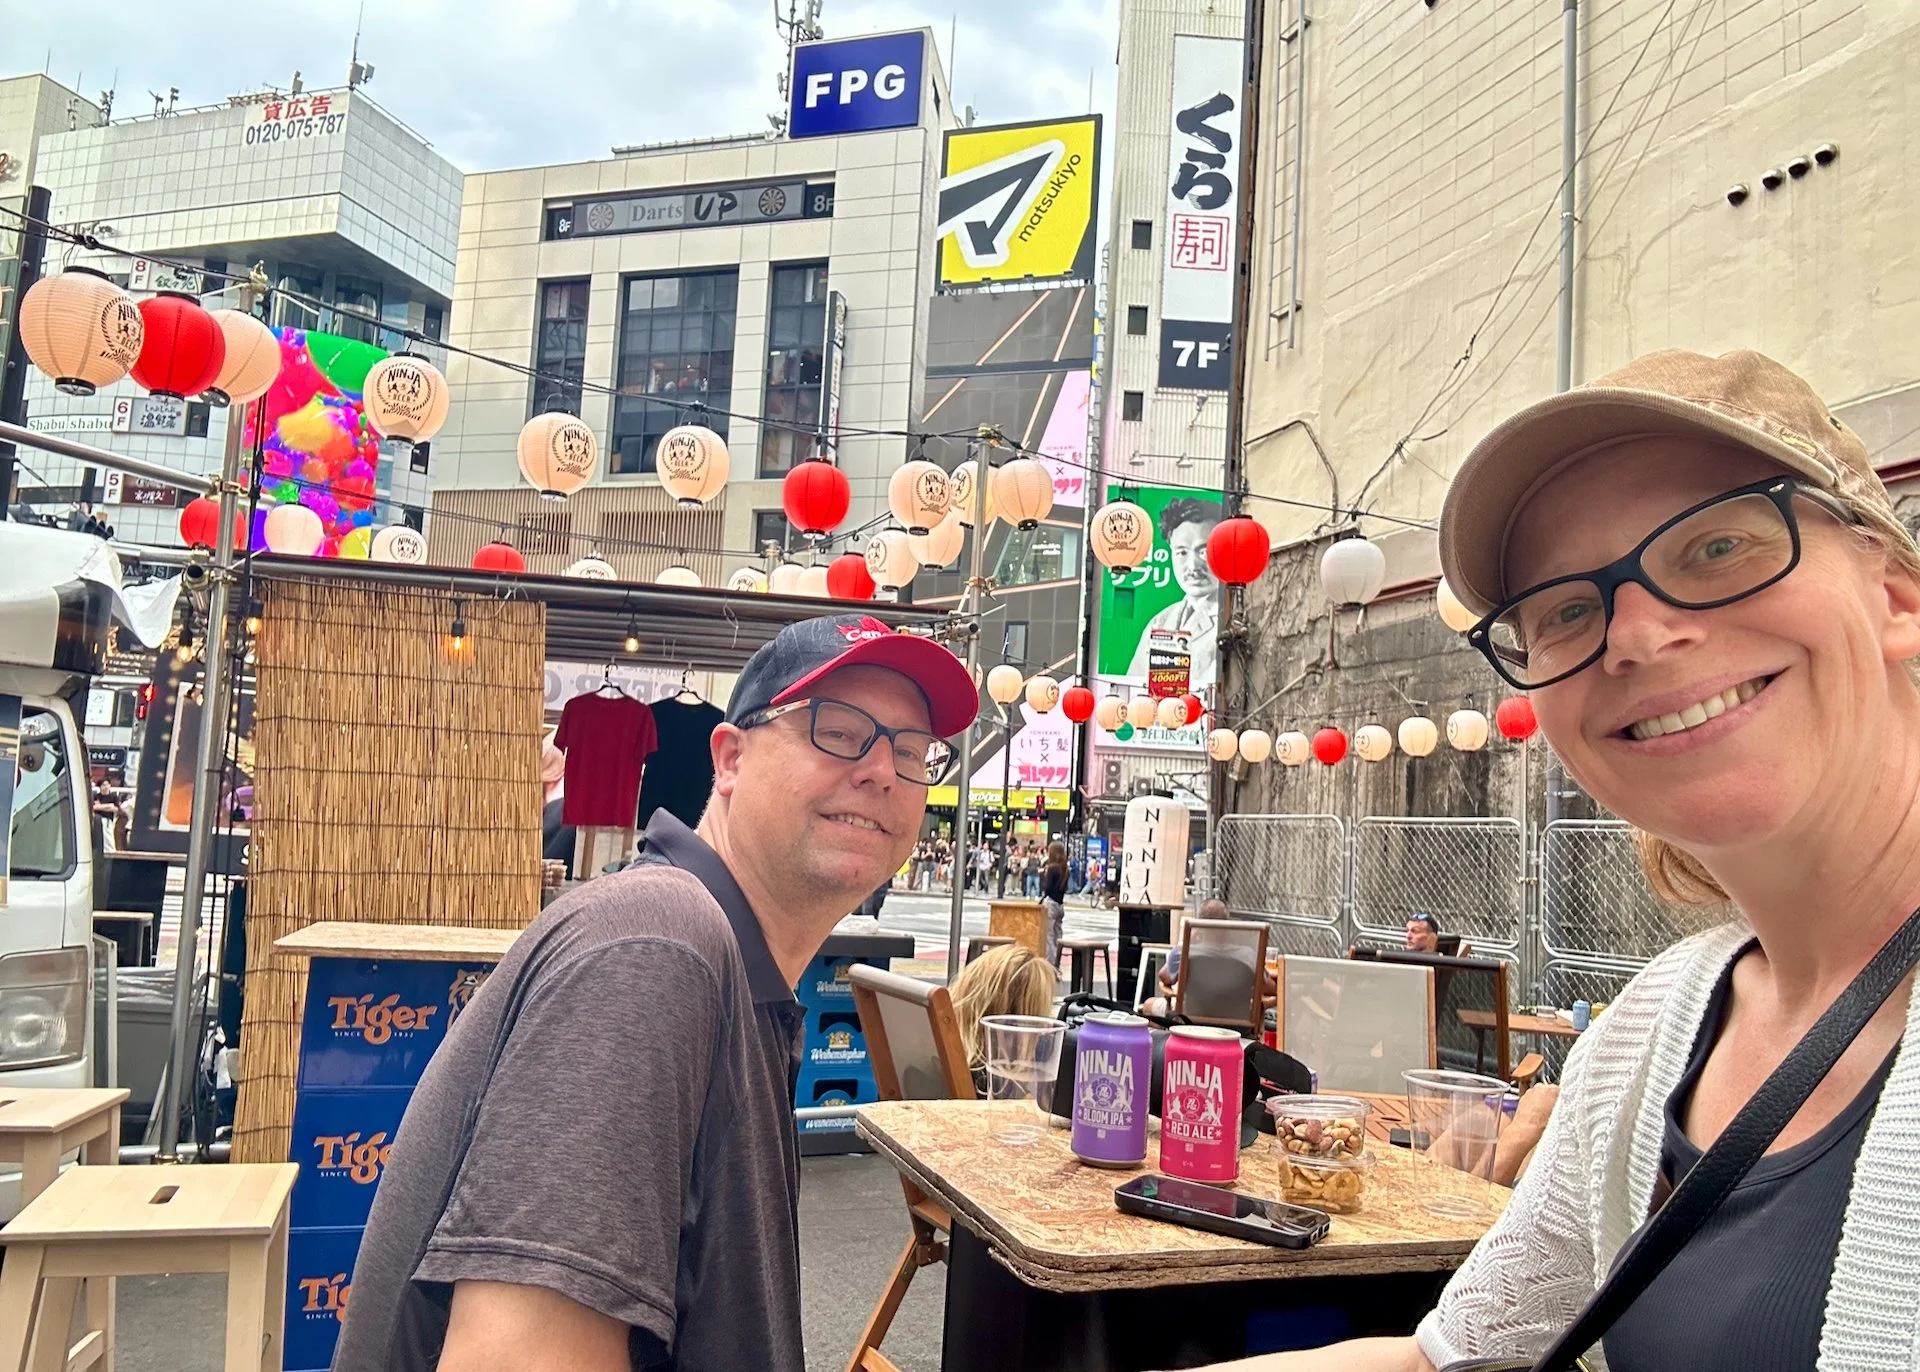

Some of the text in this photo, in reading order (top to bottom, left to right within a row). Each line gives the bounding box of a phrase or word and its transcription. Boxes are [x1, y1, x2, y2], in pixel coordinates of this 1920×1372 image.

[805, 64, 906, 109] FPG
[263, 95, 332, 122] 貸広告
[1171, 91, 1235, 210] くら
[631, 191, 738, 223] Darts UP
[814, 195, 835, 213] 8F
[1018, 154, 1082, 242] matsukiyo
[558, 218, 572, 233] 8F
[1172, 340, 1220, 368] 7F
[387, 368, 421, 389] NINJA
[392, 393, 411, 403] BEER
[29, 418, 66, 432] Shabu
[563, 429, 591, 449] NINJA
[669, 436, 697, 454] NINJA
[925, 473, 946, 489] NINJA
[1108, 512, 1134, 527] NINJA
[397, 537, 418, 549] NINJA
[845, 629, 887, 642] Can
[1020, 737, 1069, 752] いち髪
[1138, 807, 1160, 905] NINJA
[327, 993, 438, 1045] Tiger
[334, 1030, 361, 1038] SINCE
[1079, 1049, 1134, 1090] NINJA
[1166, 1060, 1224, 1104] NINJA
[1083, 1107, 1109, 1125] BLOOM
[1110, 1112, 1124, 1126] IPA
[1171, 1120, 1190, 1137] RED
[1191, 1124, 1215, 1140] ALE
[313, 1131, 395, 1184] Tige
[299, 1272, 351, 1323] Tig
